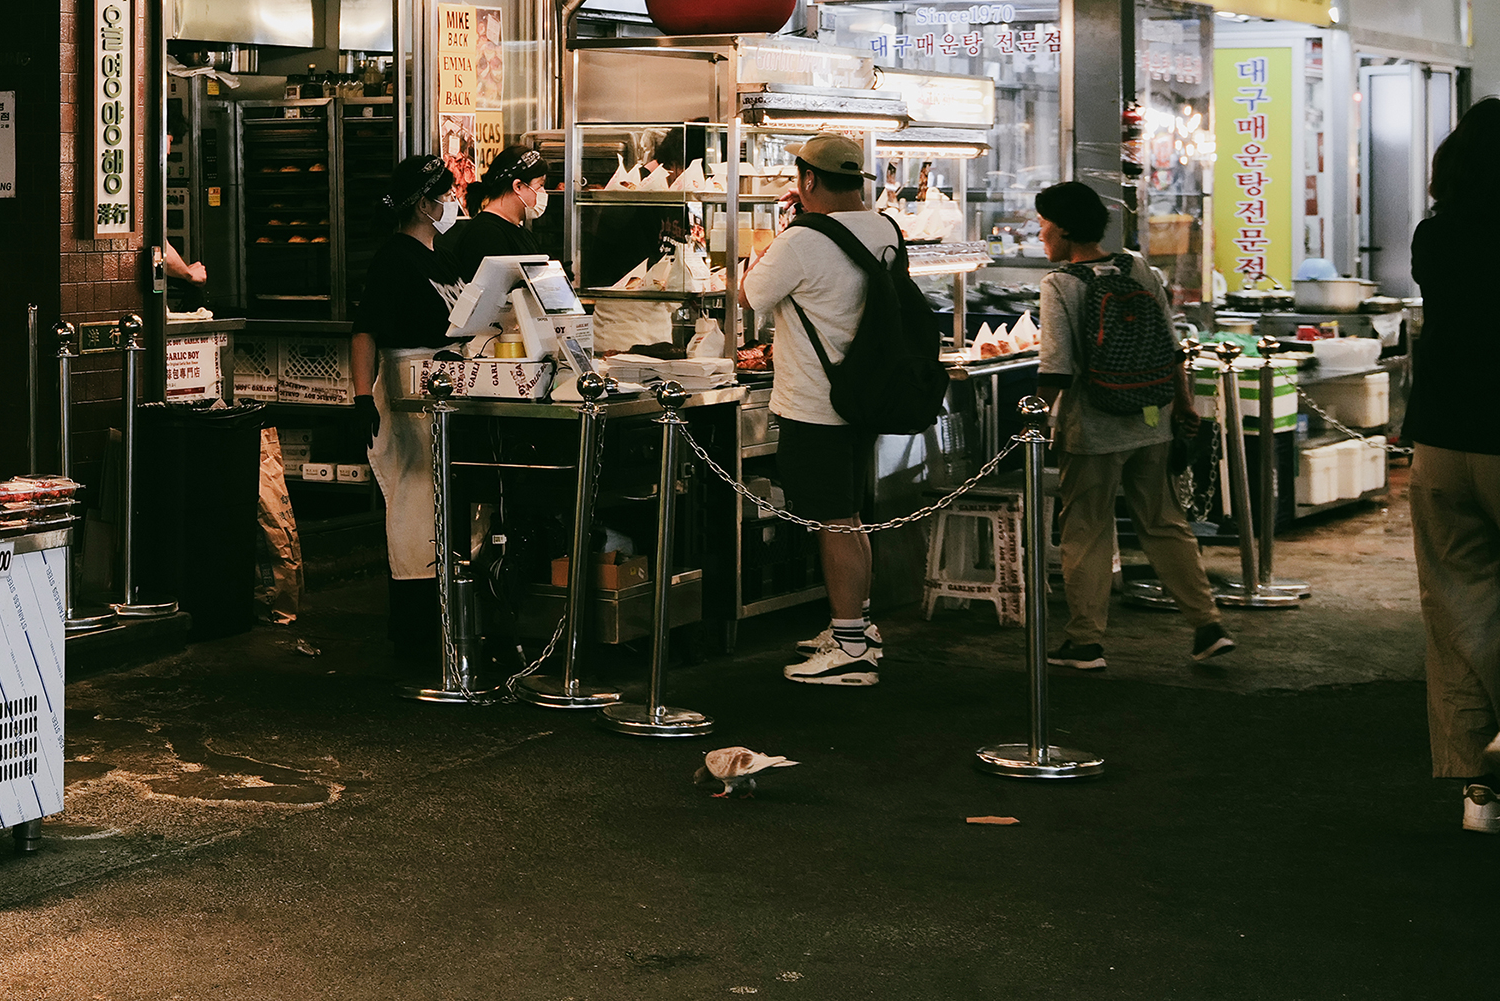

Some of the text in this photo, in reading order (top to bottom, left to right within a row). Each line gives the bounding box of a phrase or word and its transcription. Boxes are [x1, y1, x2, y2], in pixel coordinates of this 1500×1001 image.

[446, 11, 470, 30] MIKE
[447, 32, 469, 47] BACK
[869, 30, 1061, 57] 대구매운탕 전문점
[443, 56, 473, 72] EMMA
[454, 74, 463, 89] IS
[99, 4, 125, 196] 올영양행
[445, 91, 471, 106] BACK
[476, 122, 501, 144] UCAS
[1233, 57, 1270, 283] 대구매운탕전문점
[97, 202, 129, 226] 洋行
[555, 326, 566, 334] OY
[188, 351, 200, 360] BOY
[12, 593, 27, 630] STAINLESS
